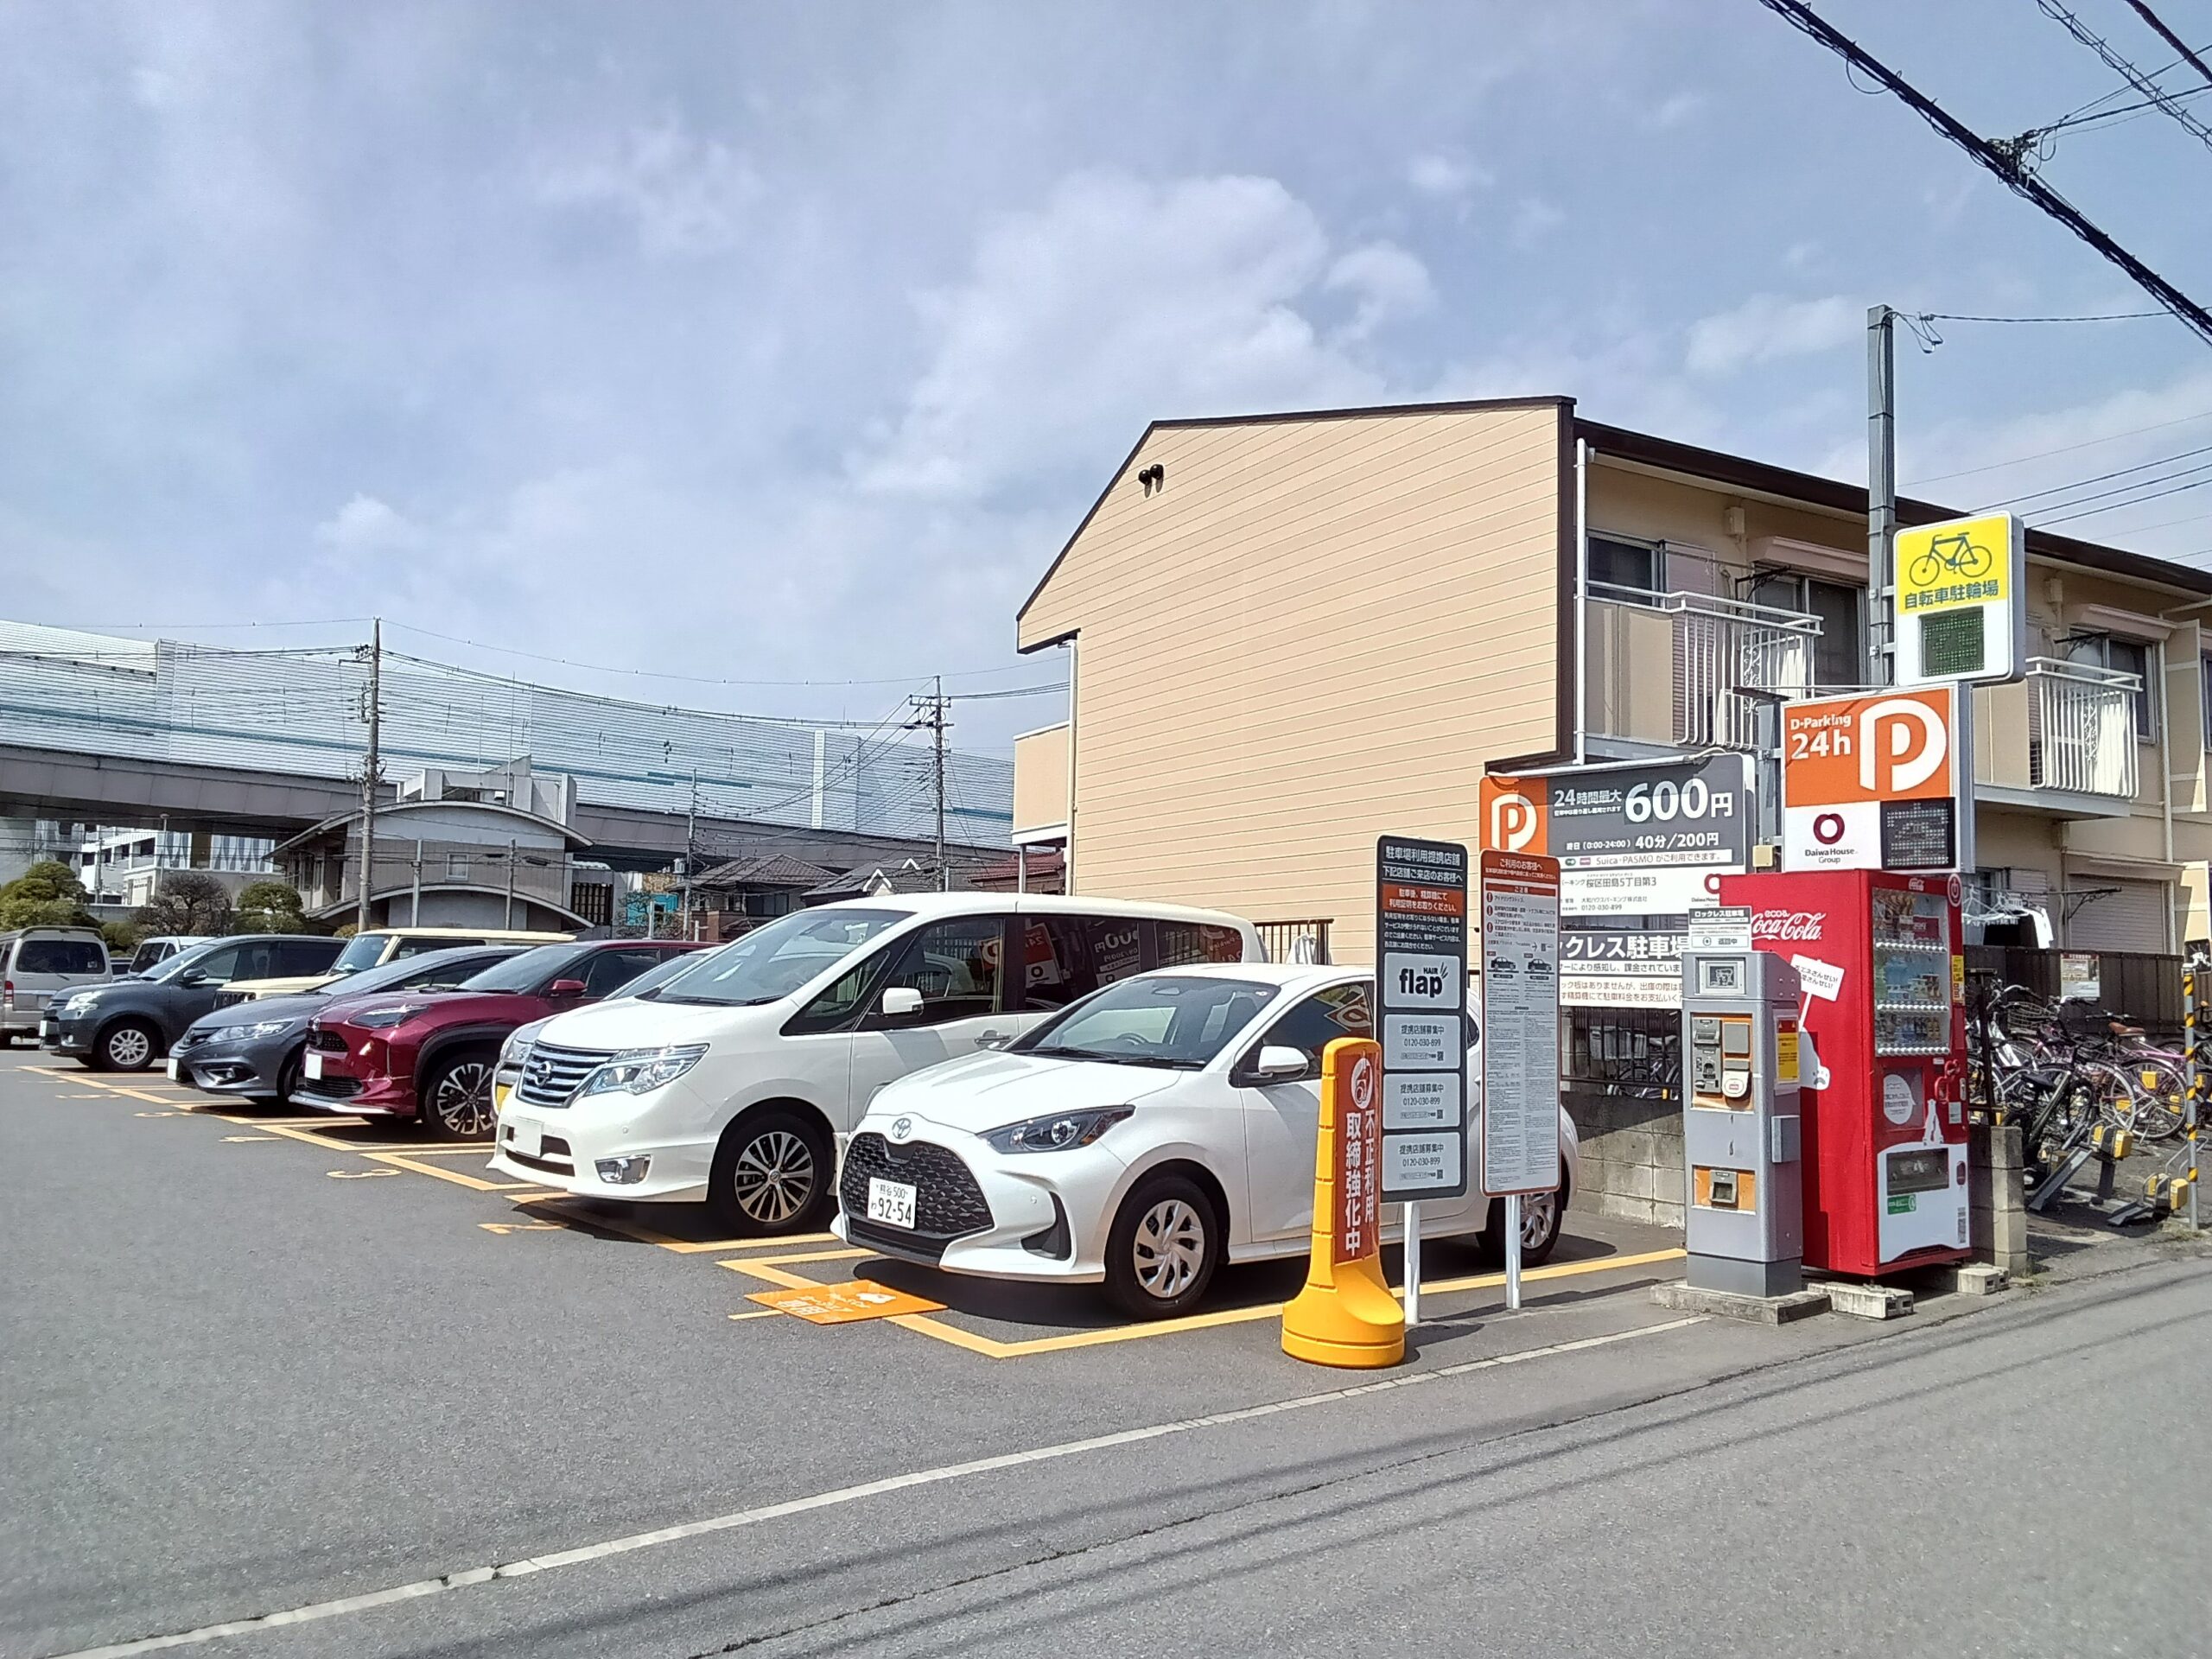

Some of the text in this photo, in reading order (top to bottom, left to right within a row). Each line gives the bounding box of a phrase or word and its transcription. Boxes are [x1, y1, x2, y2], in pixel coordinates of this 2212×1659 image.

[1904, 579, 1999, 609] 自転車駐輪場
[1790, 715, 1851, 730] D-Parking
[1791, 728, 1851, 760] 24h
[1554, 778, 1733, 823] 24時間最大 600円
[1385, 846, 1460, 866] 駐車場利用提携店舗
[1382, 866, 1463, 883] 下記店舗ご来店のお客様へ
[1694, 909, 1745, 918] ロックレス駐車場
[1399, 968, 1443, 998] flap
[1401, 1024, 1445, 1035] 提携店舗募集中
[1400, 1084, 1444, 1094] 提携店舗募集中
[1402, 1096, 1440, 1106] 0120-030-899
[1399, 1143, 1444, 1155] 提携店舗募集中
[1364, 1109, 1376, 1224] 不正利用
[1402, 1157, 1440, 1167] 0120-030-899
[1344, 1112, 1362, 1257] 取締強化中
